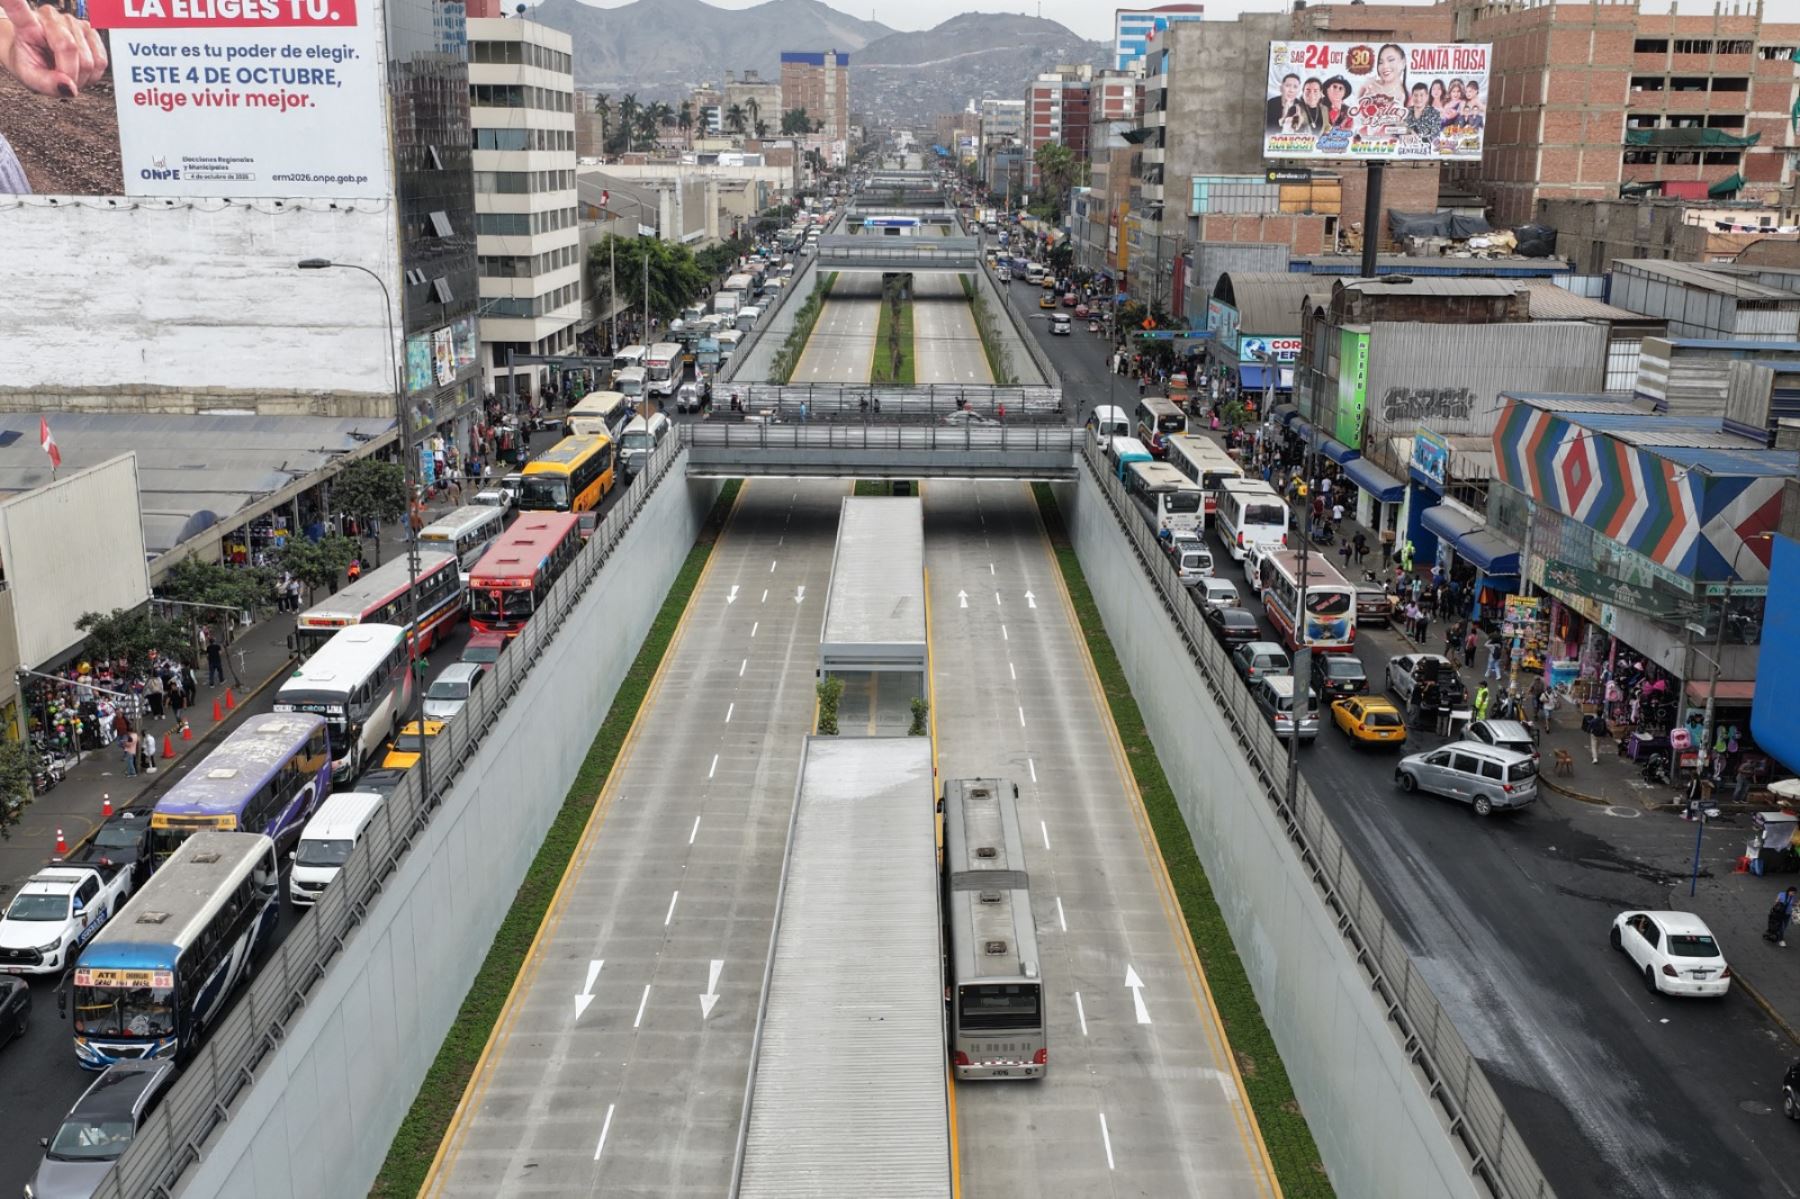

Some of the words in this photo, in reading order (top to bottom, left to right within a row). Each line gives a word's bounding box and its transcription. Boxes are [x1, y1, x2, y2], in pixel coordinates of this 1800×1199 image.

[123, 0, 165, 18] LA
[173, 0, 280, 19] ELIGES
[128, 42, 177, 57] Votar
[181, 45, 201, 57] es
[204, 43, 222, 57] tu
[226, 43, 276, 62] poder
[281, 44, 302, 58] de
[306, 44, 360, 63] elegir.
[1290, 51, 1305, 64] SAB
[1305, 44, 1330, 69] 24
[1331, 51, 1344, 64] OCT
[1351, 49, 1371, 65] 30
[1410, 49, 1449, 70] SANTA
[1453, 49, 1486, 70] ROSA
[131, 66, 180, 83] ESTE
[186, 66, 199, 84] 4
[204, 67, 231, 84] DE
[236, 67, 342, 88] OCTUBRE,
[133, 88, 187, 112] elige
[192, 88, 240, 107] vivir
[246, 89, 316, 112] mejor.
[141, 169, 180, 181] ONPE
[272, 173, 368, 184] erm2026.onpe.gob.pe
